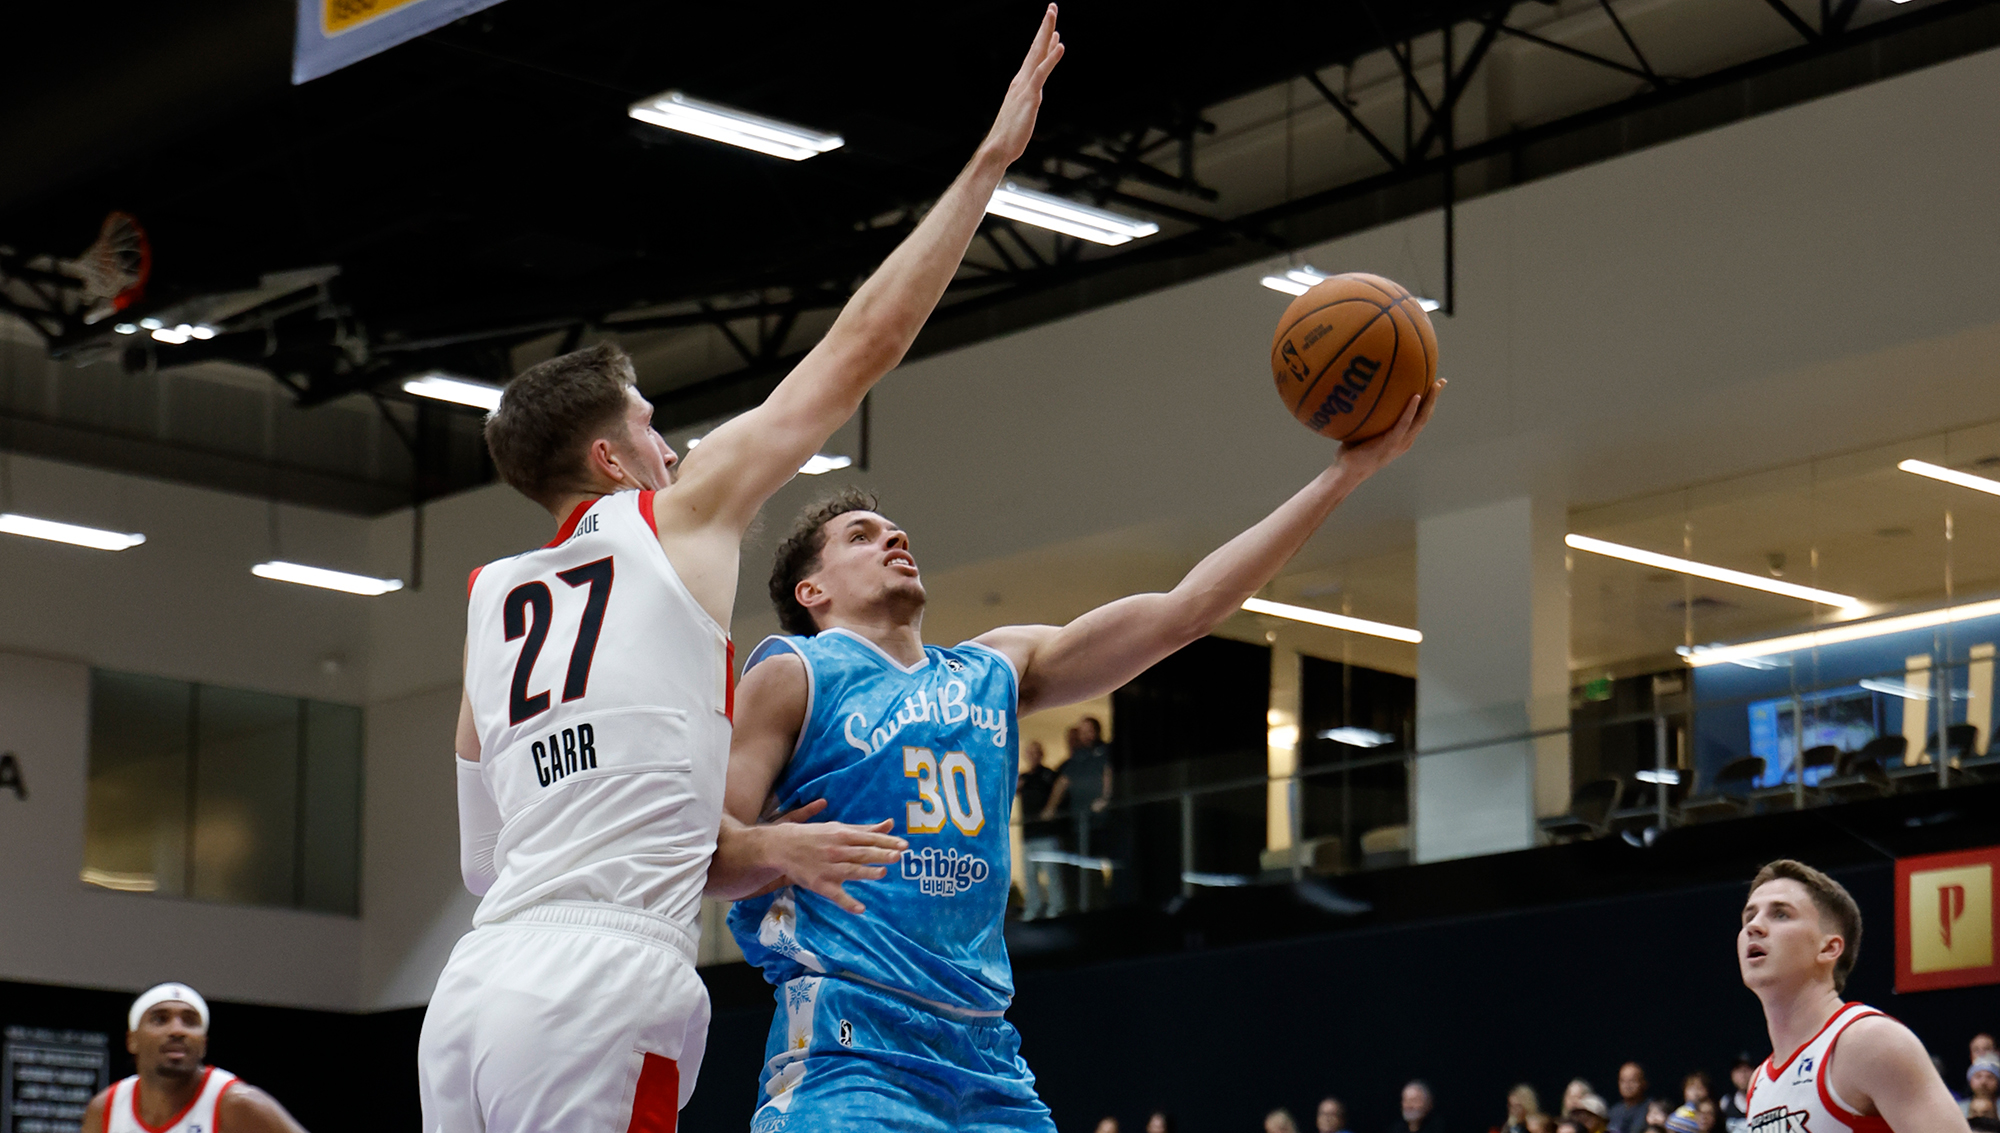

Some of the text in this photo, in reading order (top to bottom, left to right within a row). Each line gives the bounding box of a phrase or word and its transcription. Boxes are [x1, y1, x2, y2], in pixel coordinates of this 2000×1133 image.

[1307, 355, 1381, 431] Wilson
[504, 556, 614, 727] 27
[532, 723, 597, 788] CARR
[844, 681, 1008, 757] South Bay
[902, 746, 986, 837] 30
[901, 847, 988, 890] bibigo
[922, 880, 955, 895] 비비고
